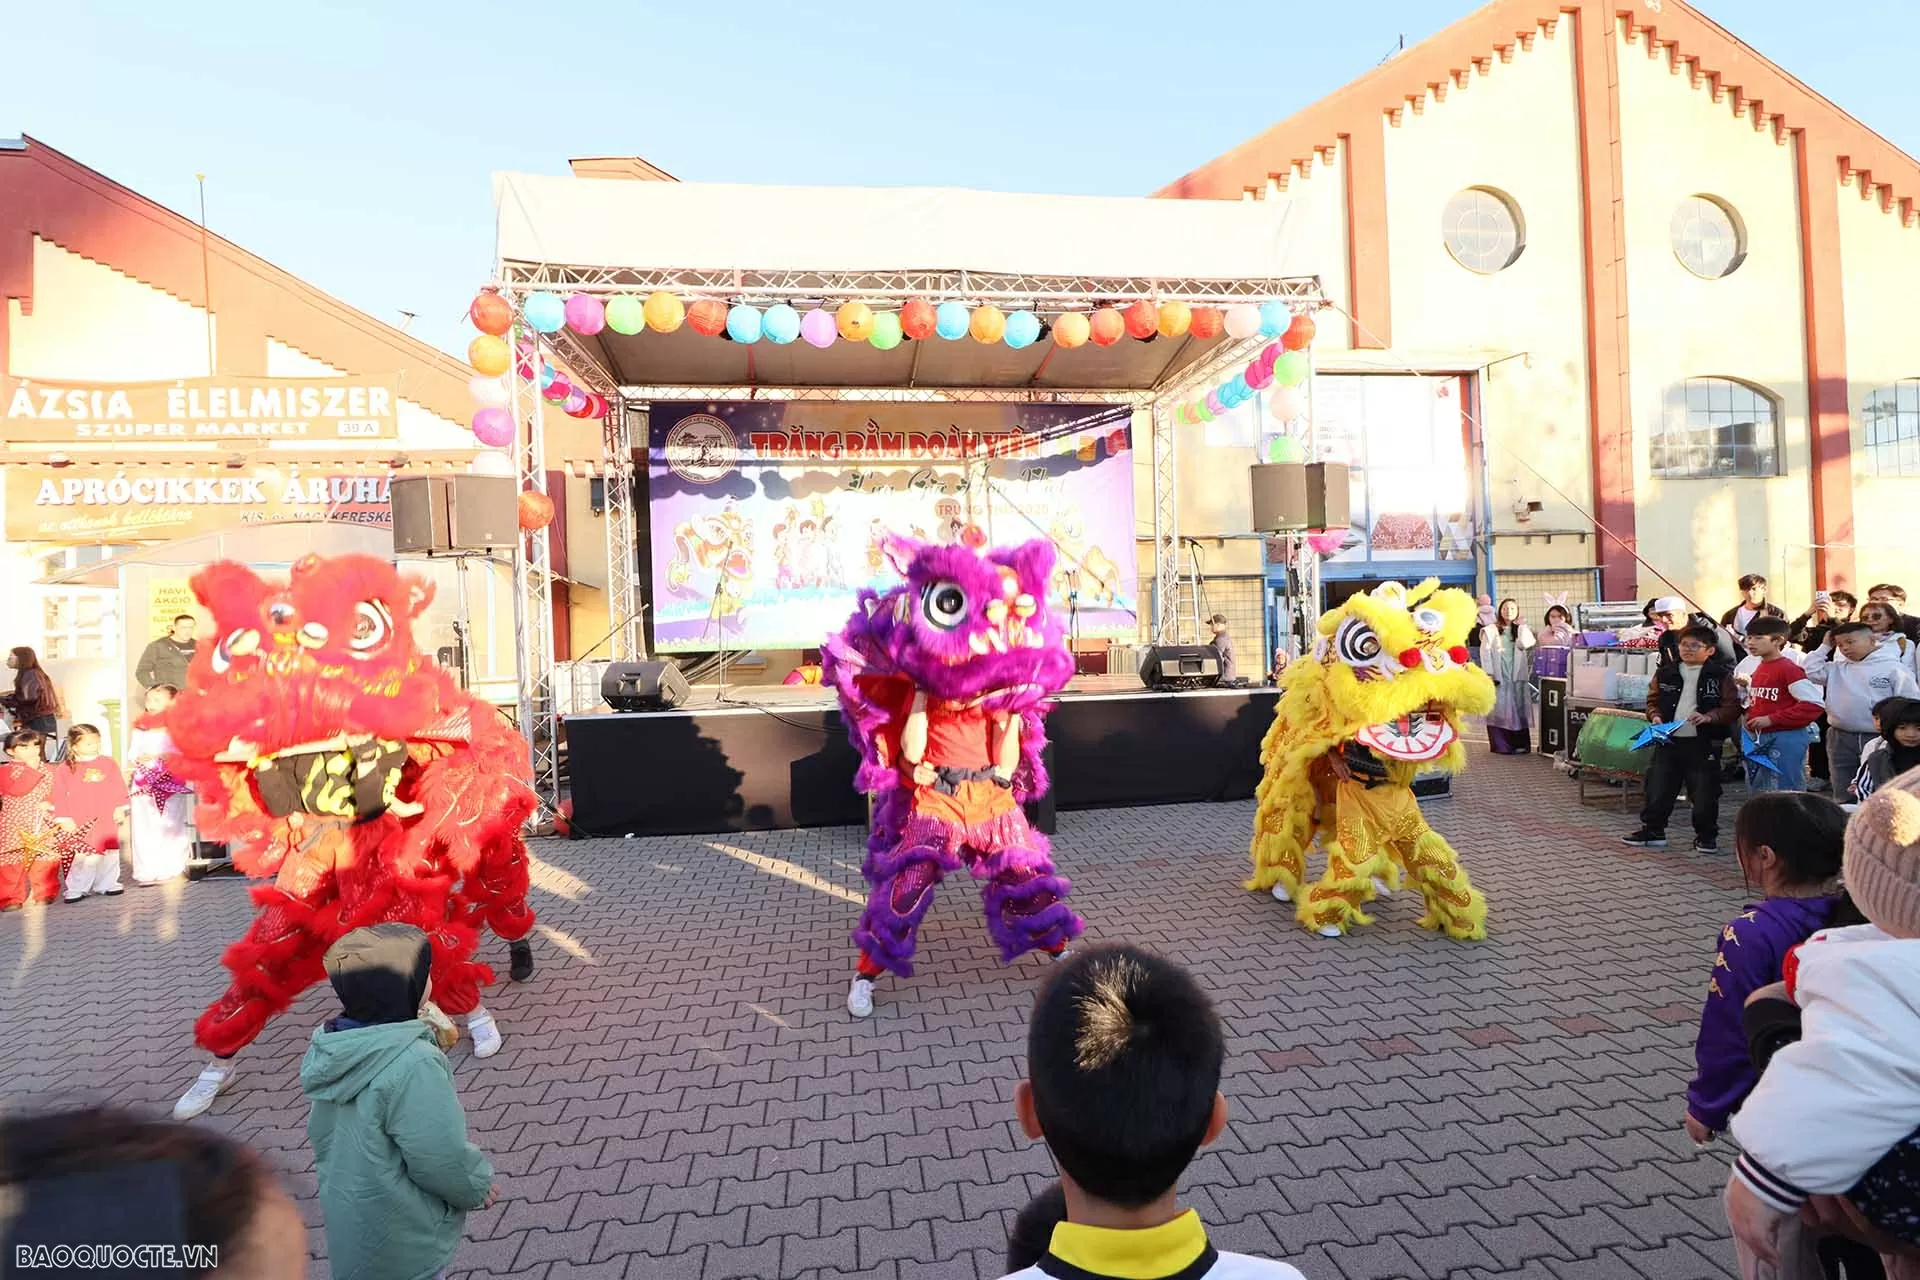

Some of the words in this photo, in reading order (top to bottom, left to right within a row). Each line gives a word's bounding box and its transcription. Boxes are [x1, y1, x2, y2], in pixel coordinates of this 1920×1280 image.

[8, 379, 134, 419] ÁZSIA
[168, 379, 392, 418] ÉLELMISZER
[76, 423, 185, 437] SZUPER
[195, 422, 311, 435] MARKET
[750, 425, 843, 459] TRĂNG
[845, 418, 905, 459] RẰM
[36, 470, 268, 506] APRÓCIKKEK
[158, 587, 188, 596] HAVI
[154, 596, 191, 605] AKCIÓ
[1570, 711, 1590, 721] RA
